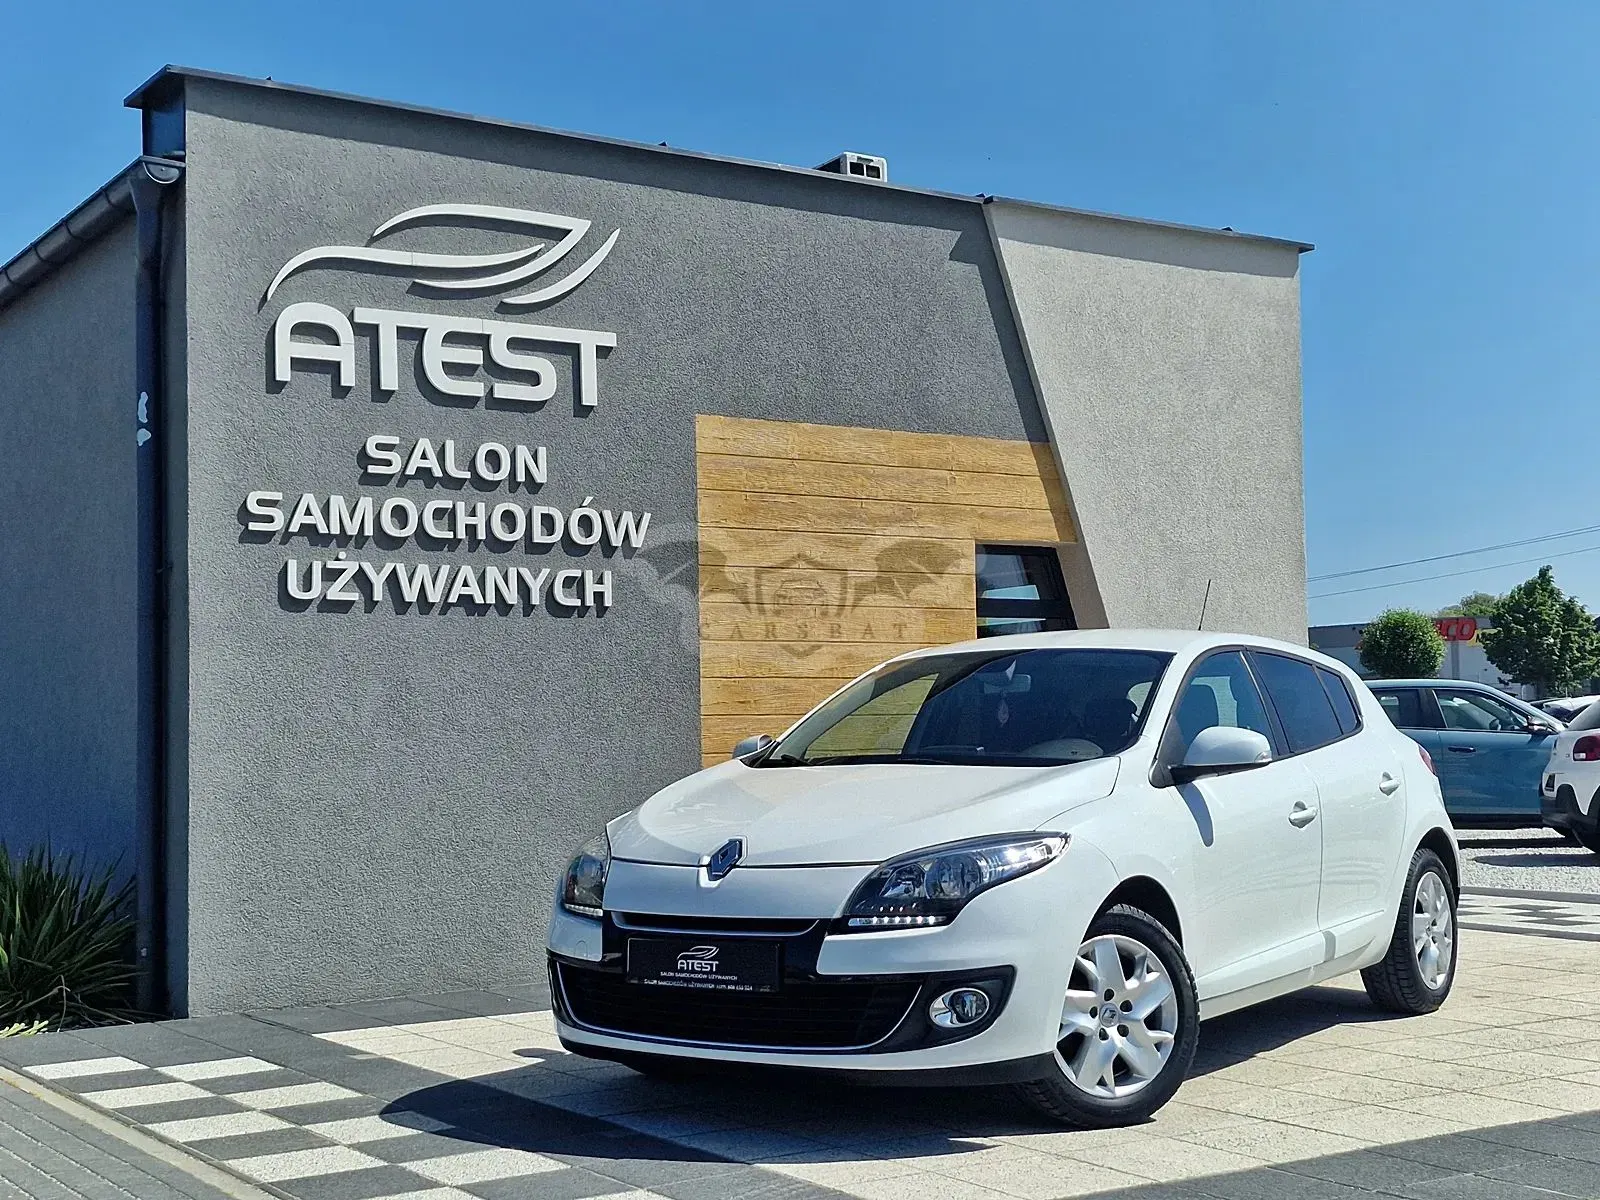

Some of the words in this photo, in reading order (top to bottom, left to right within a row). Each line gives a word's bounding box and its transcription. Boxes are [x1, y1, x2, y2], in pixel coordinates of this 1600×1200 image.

[275, 302, 617, 407] ATEST
[365, 434, 548, 483] SALON
[246, 491, 652, 549] SAMOCHODÓW
[286, 551, 613, 608] UŻYWANYCH
[677, 959, 719, 972] ATEST
